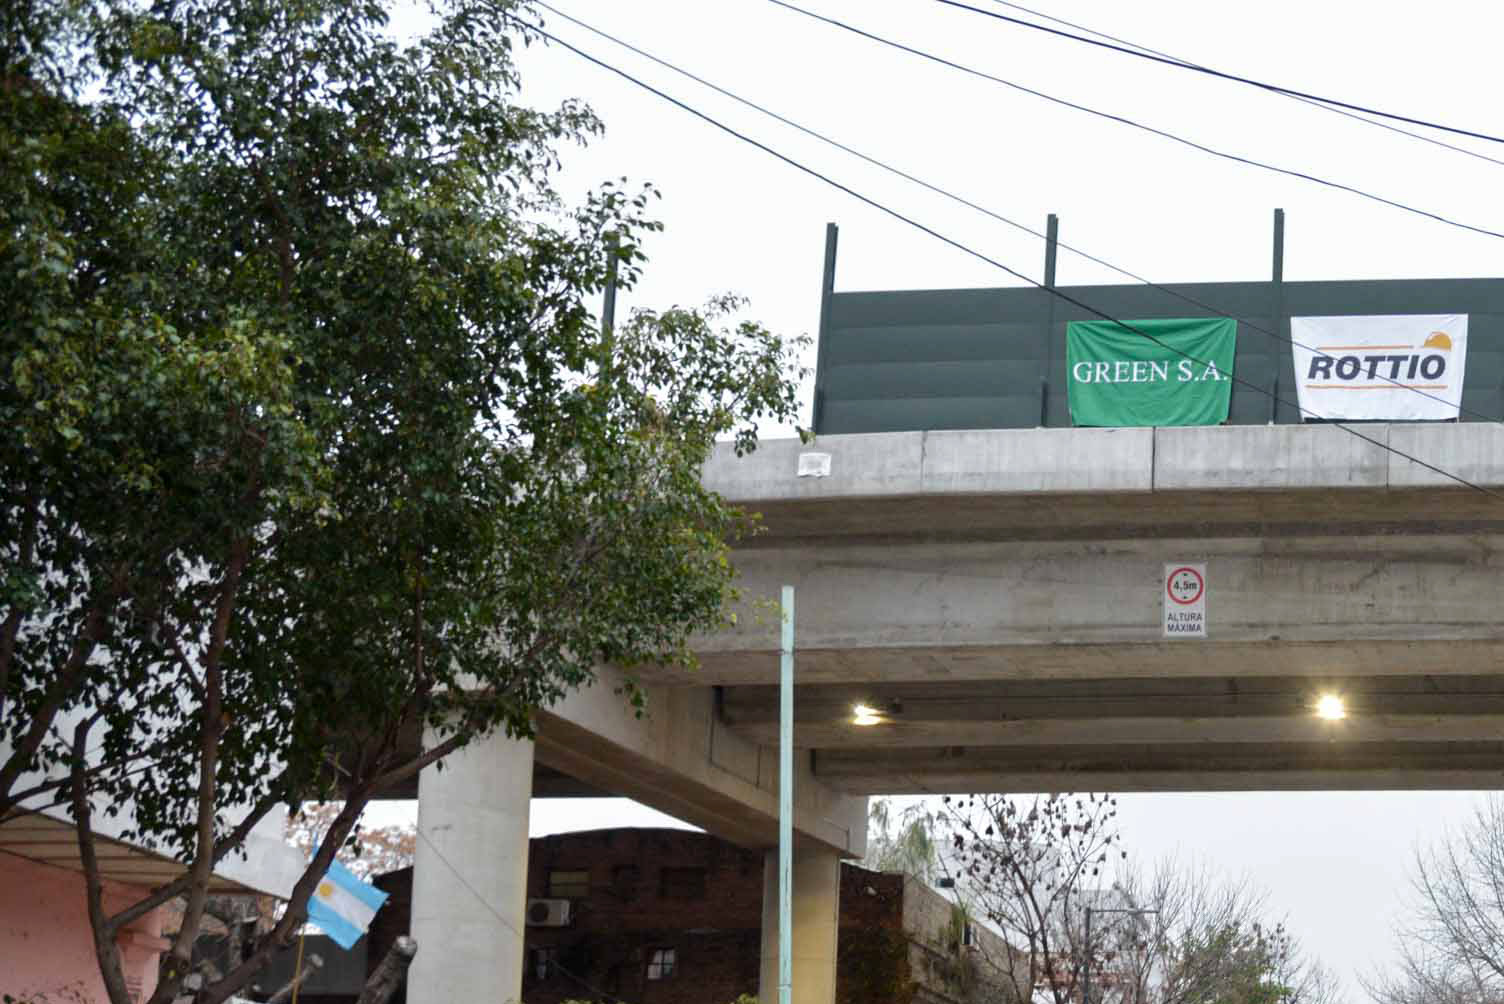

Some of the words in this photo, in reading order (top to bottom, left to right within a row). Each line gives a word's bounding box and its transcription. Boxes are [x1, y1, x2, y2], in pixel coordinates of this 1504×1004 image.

[1073, 361, 1169, 384] GREEN
[1177, 360, 1229, 382] S.A.
[1307, 354, 1446, 381] ROTTIO
[1167, 612, 1202, 621] ALTURA
